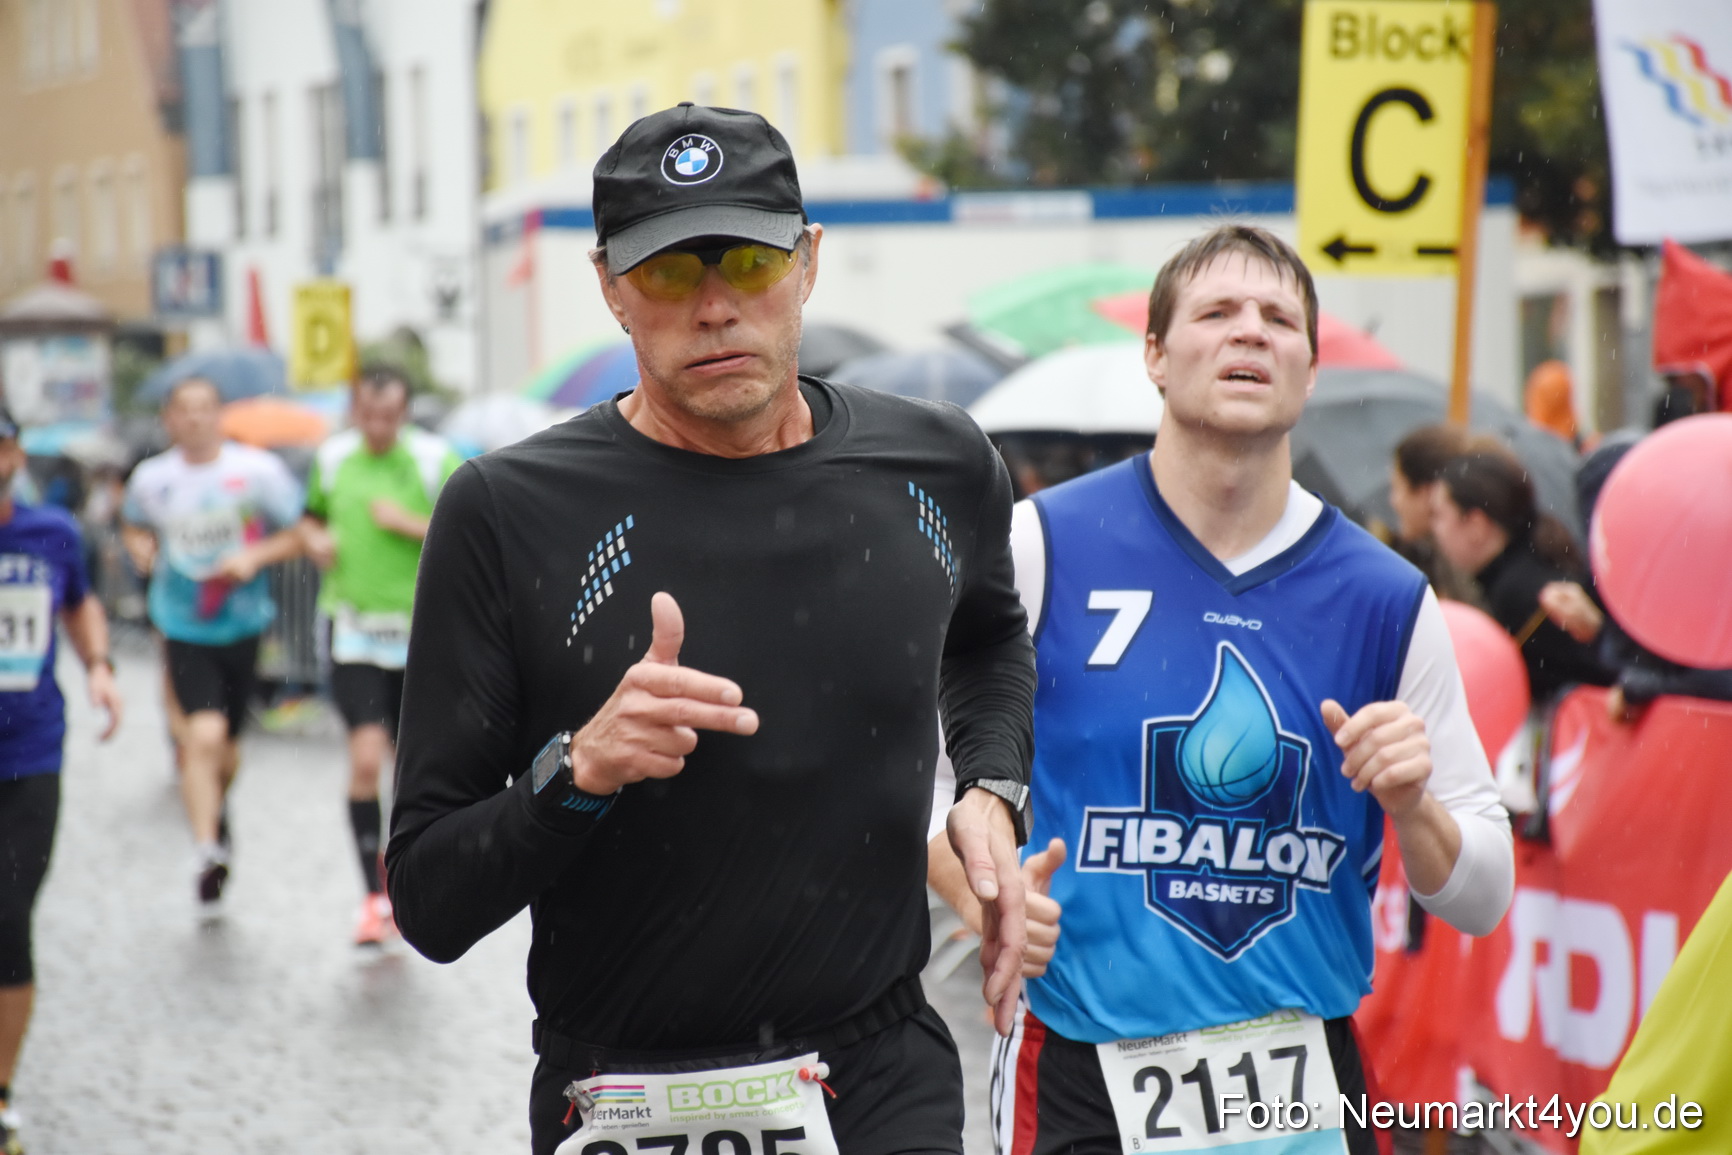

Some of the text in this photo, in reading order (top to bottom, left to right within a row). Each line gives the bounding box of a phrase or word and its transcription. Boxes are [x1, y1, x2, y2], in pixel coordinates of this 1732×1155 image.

[1329, 12, 1472, 64] Block
[668, 137, 715, 159] BMW
[1349, 86, 1435, 214] C
[305, 308, 343, 365] D
[1085, 589, 1154, 671] 7
[1117, 1032, 1188, 1053] NeuerMarkt
[666, 1069, 800, 1113] BOCK
[670, 1100, 805, 1124] inspired by smart concepts
[1132, 1044, 1308, 1140] 2117
[1132, 1137, 1141, 1150] B
